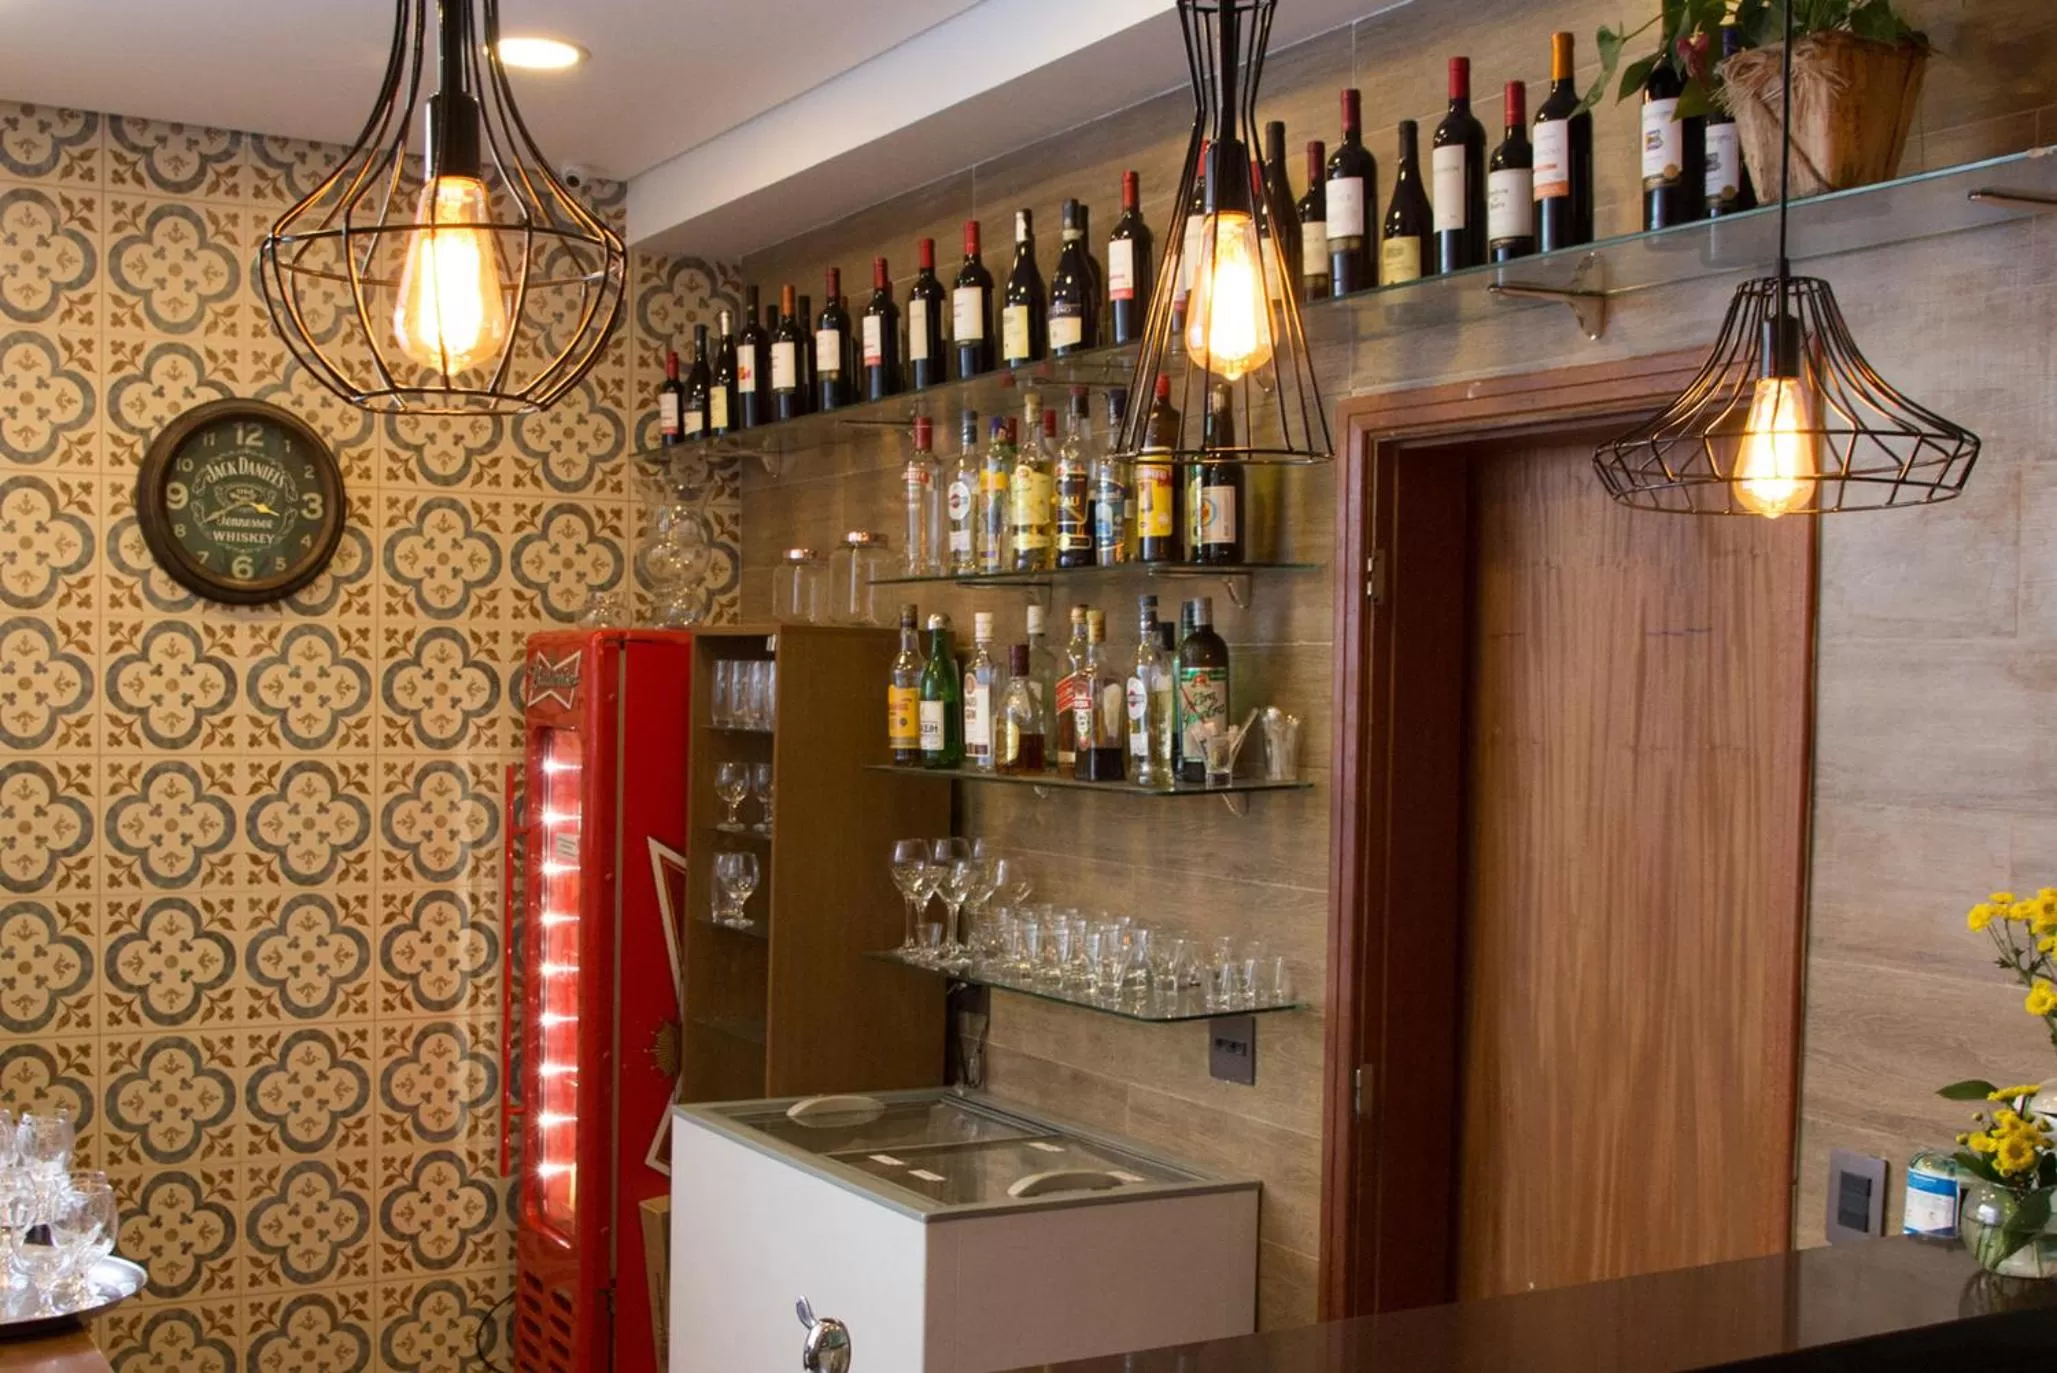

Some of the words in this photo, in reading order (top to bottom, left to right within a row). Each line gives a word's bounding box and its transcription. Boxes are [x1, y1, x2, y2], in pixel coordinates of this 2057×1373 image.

[203, 432, 216, 446] 11
[234, 423, 264, 446] 12
[284, 440, 291, 453] 1
[176, 457, 194, 473] 10
[205, 461, 238, 483] JACK
[304, 465, 315, 480] 2
[166, 482, 189, 510] 9
[302, 492, 323, 520] 3
[174, 523, 187, 538] 8
[212, 530, 276, 545] WHISKEY
[301, 534, 312, 548] 4
[198, 550, 210, 565] 7
[275, 556, 287, 572] 5
[231, 555, 254, 580] 6
